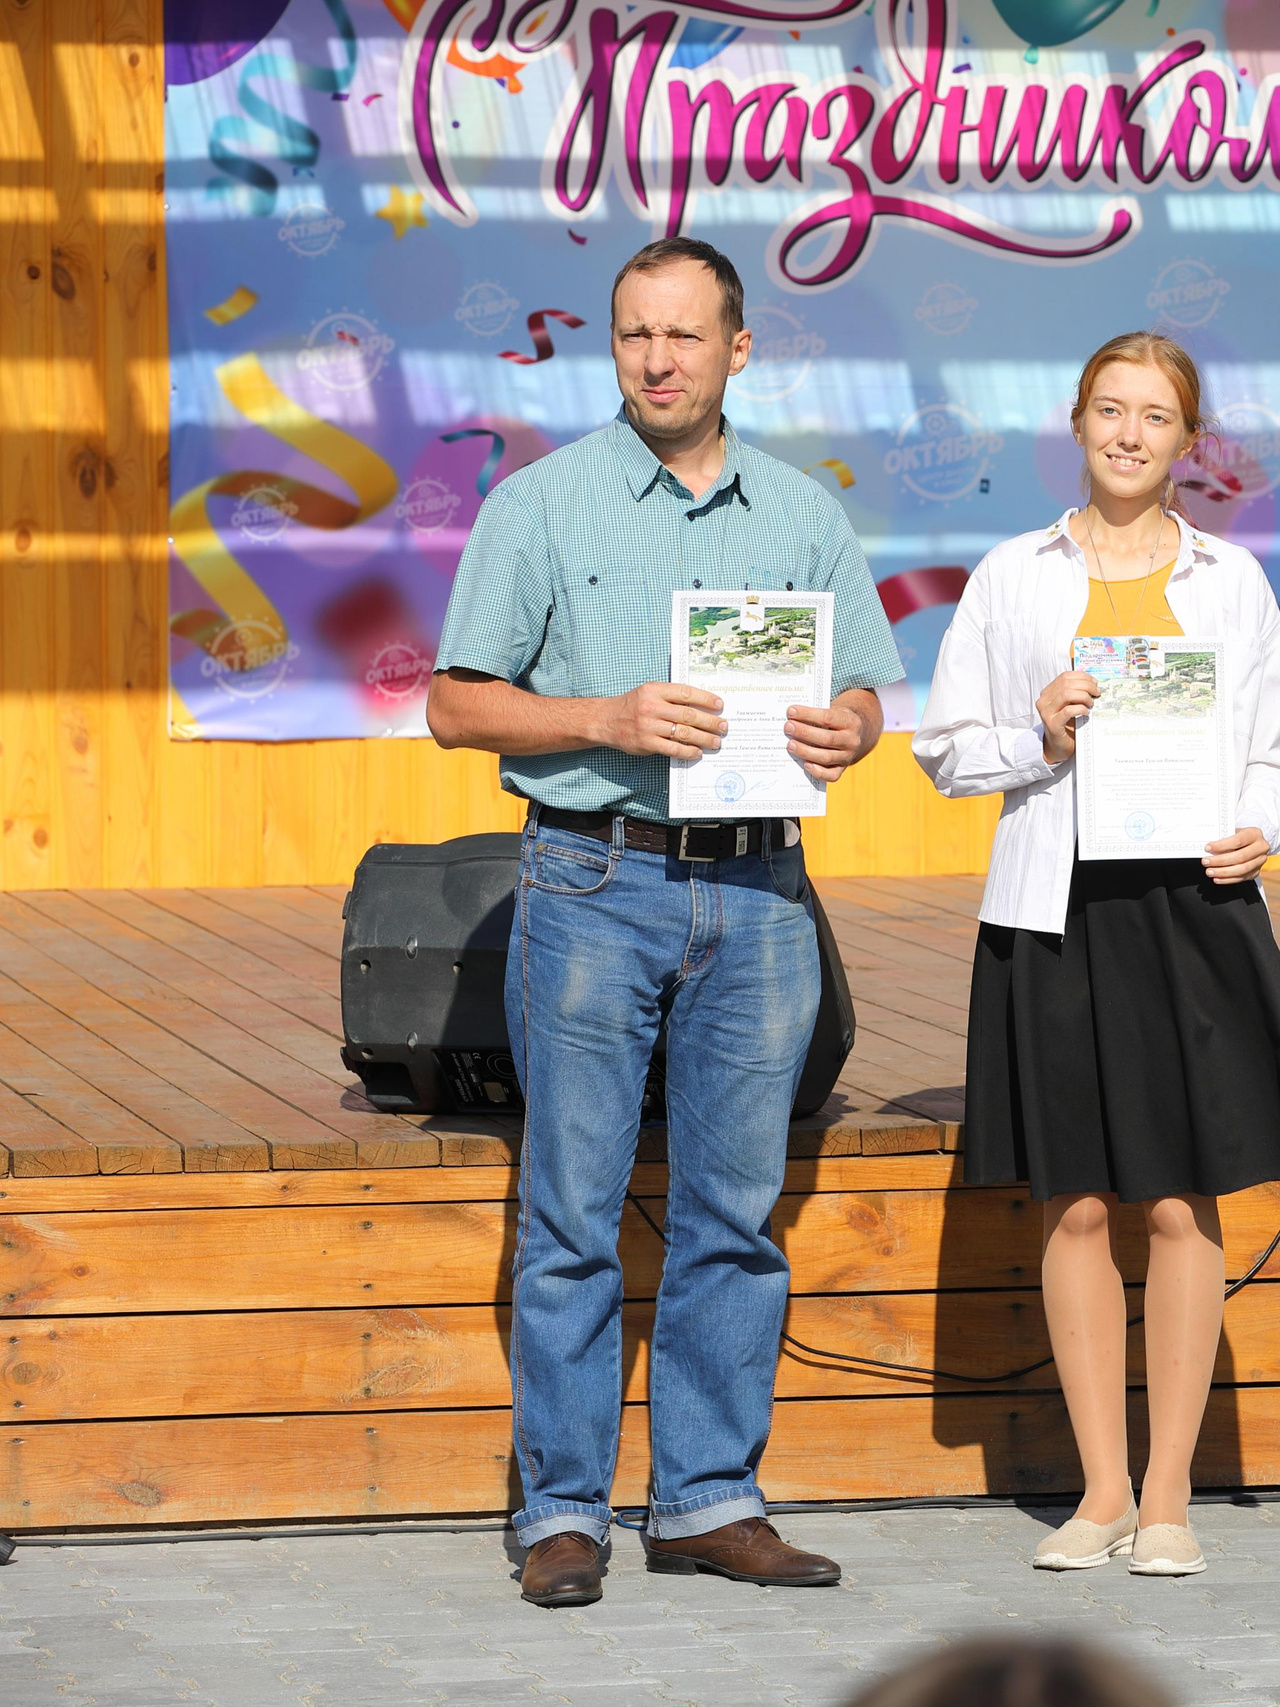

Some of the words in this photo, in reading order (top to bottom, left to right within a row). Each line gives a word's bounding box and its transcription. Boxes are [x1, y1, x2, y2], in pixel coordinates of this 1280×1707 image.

[278, 215, 346, 242] ОКТЯБРЬ
[1146, 278, 1231, 309] ОКТЯБРЬ
[454, 297, 521, 322] ОКТЯБРЬ
[914, 296, 980, 320] ОКТЯБРЬ
[757, 332, 827, 363] ЯБРЬ
[884, 430, 1004, 475] ОКТЯБРЬ
[231, 502, 299, 527] ОКТЯБРЬ
[394, 493, 462, 521] ОКТЯБРЬ
[200, 641, 301, 677] ОКТЯБРЬ
[365, 657, 432, 685] ОКТЯБРЬ
